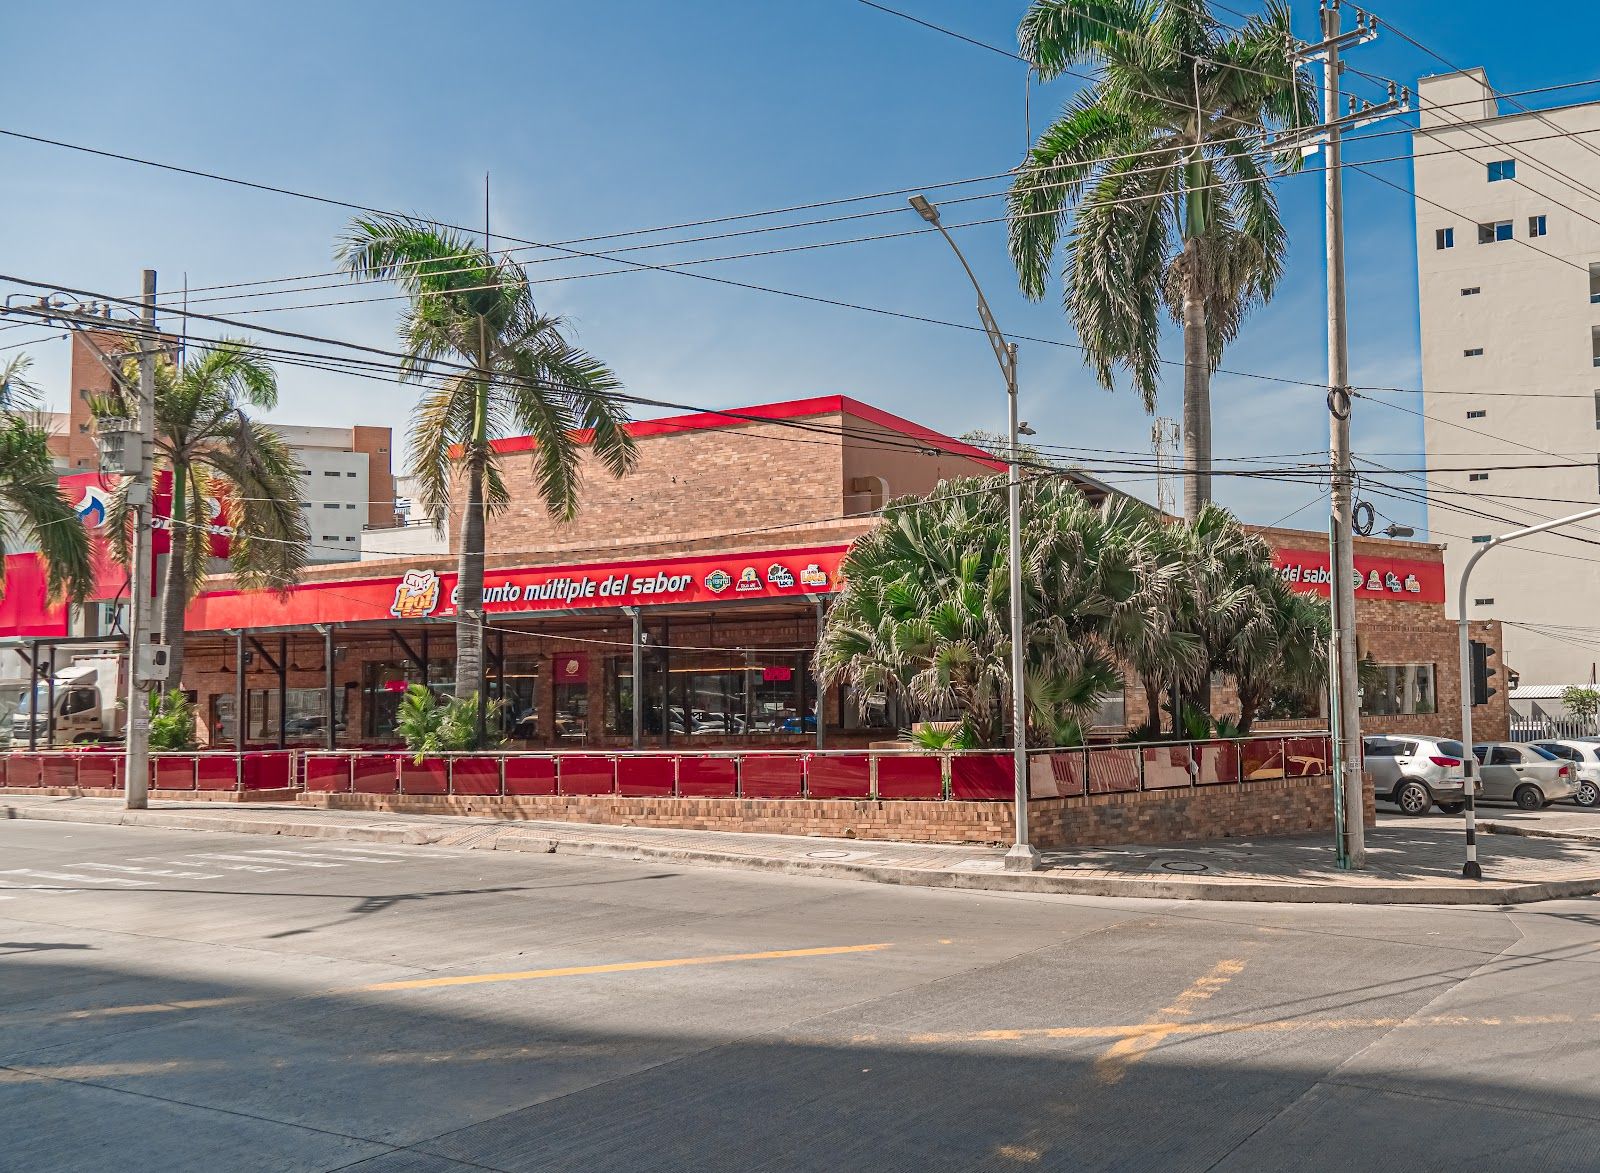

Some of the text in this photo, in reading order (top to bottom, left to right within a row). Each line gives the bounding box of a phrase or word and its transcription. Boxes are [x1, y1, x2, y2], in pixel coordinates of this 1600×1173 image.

[1281, 563, 1302, 582] del
[1303, 565, 1332, 584] sabo
[482, 581, 521, 603] unto
[523, 577, 596, 603] múltiple
[600, 573, 628, 596] del
[631, 572, 691, 596] sabor
